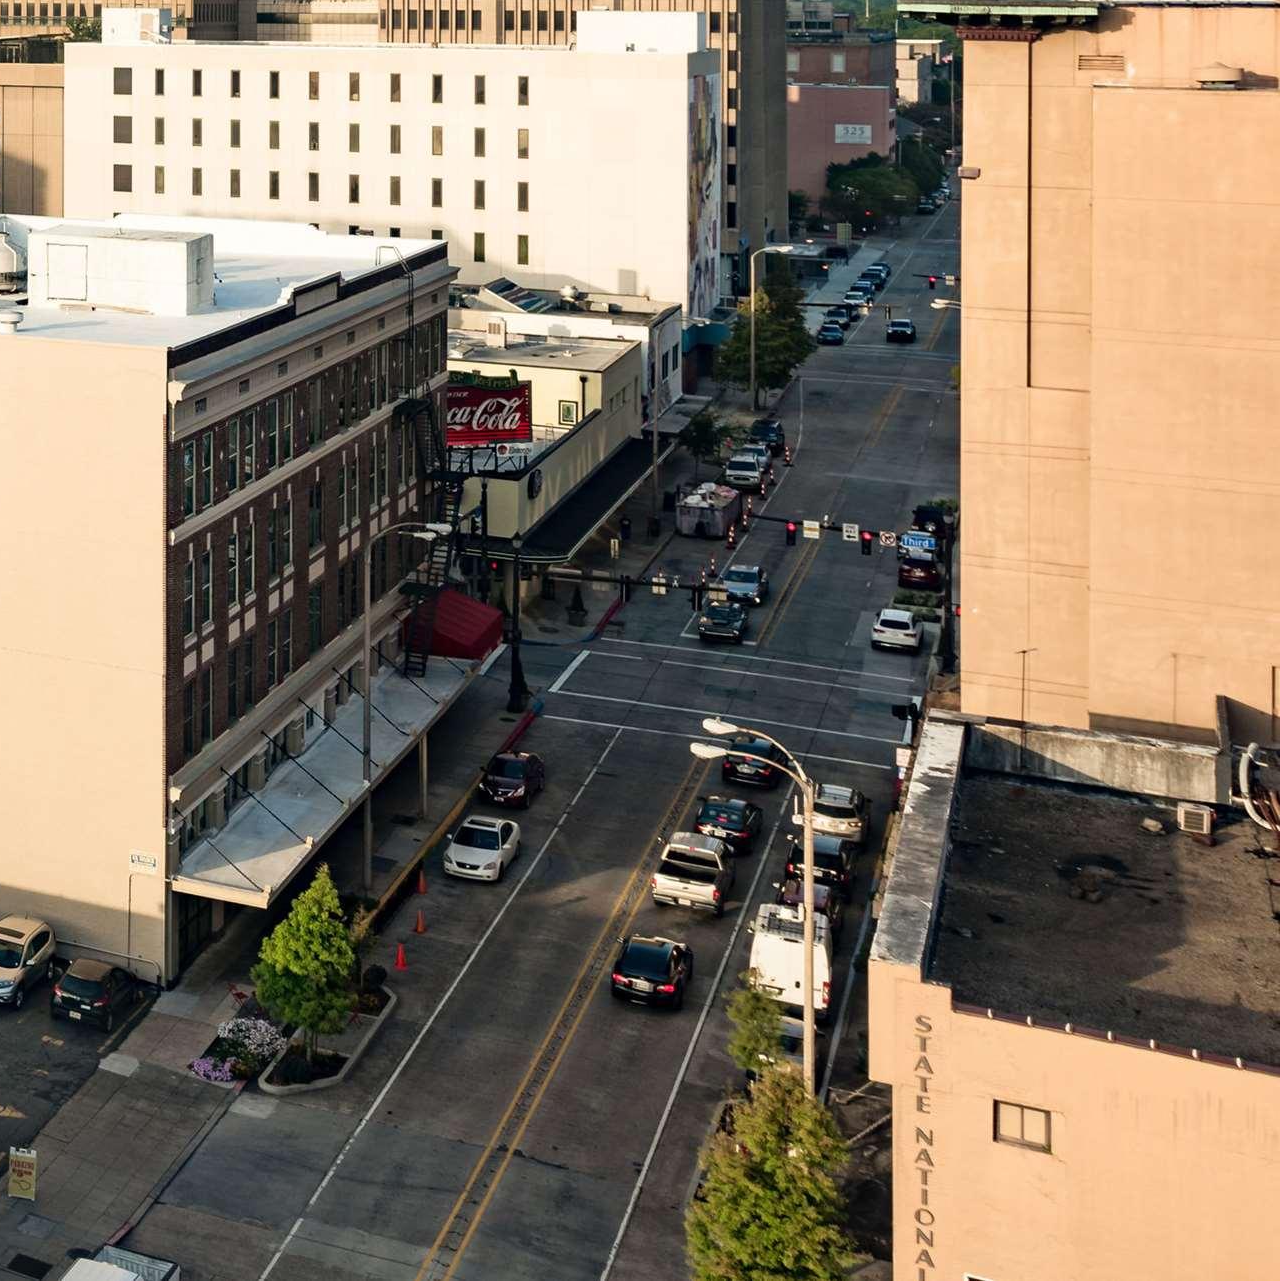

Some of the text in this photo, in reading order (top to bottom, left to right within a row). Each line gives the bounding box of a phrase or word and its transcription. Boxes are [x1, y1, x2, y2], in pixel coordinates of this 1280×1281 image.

[447, 397, 524, 431] ca-Cola
[903, 537, 929, 547] Third
[913, 1014, 934, 1114] STATE
